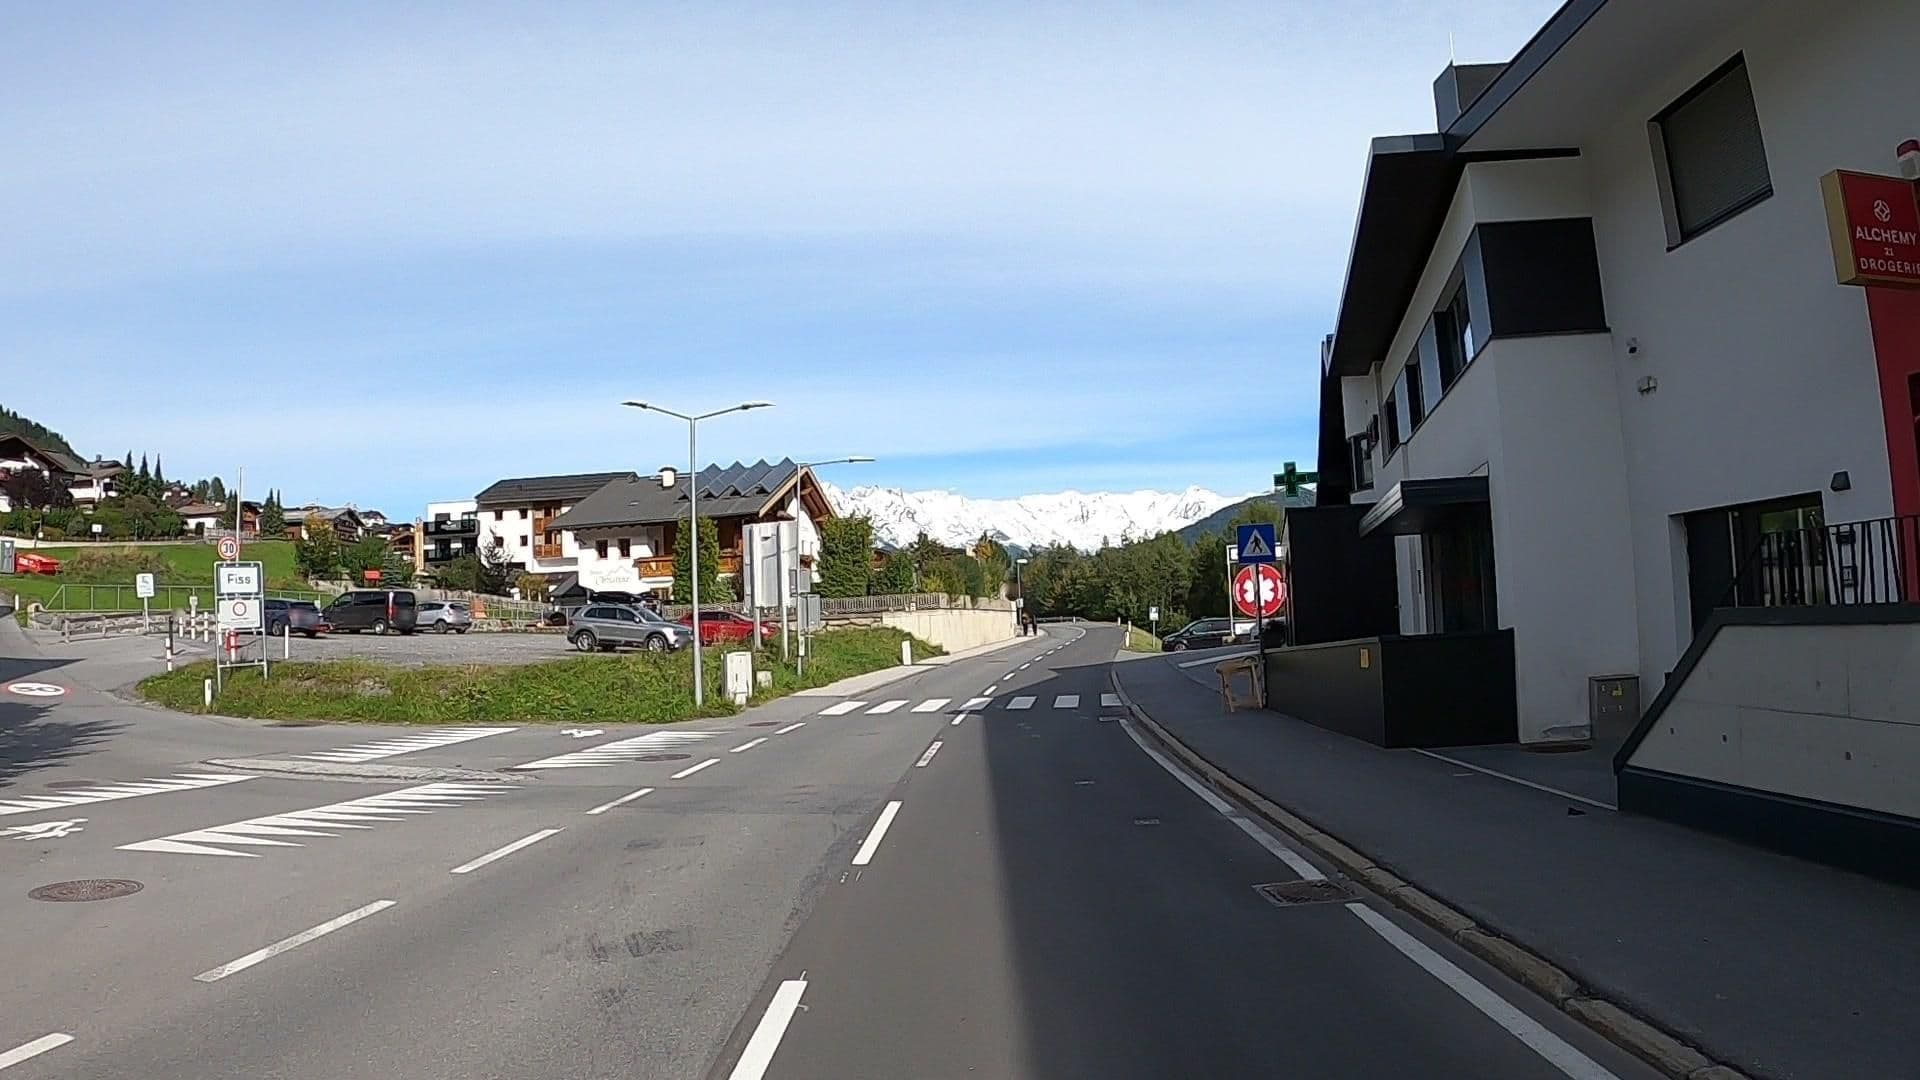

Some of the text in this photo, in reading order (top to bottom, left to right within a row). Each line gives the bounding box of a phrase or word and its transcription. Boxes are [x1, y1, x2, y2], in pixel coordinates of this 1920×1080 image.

[1856, 225, 1917, 246] ALCHEMY
[223, 543, 235, 553] 30
[227, 573, 250, 585] Fiss
